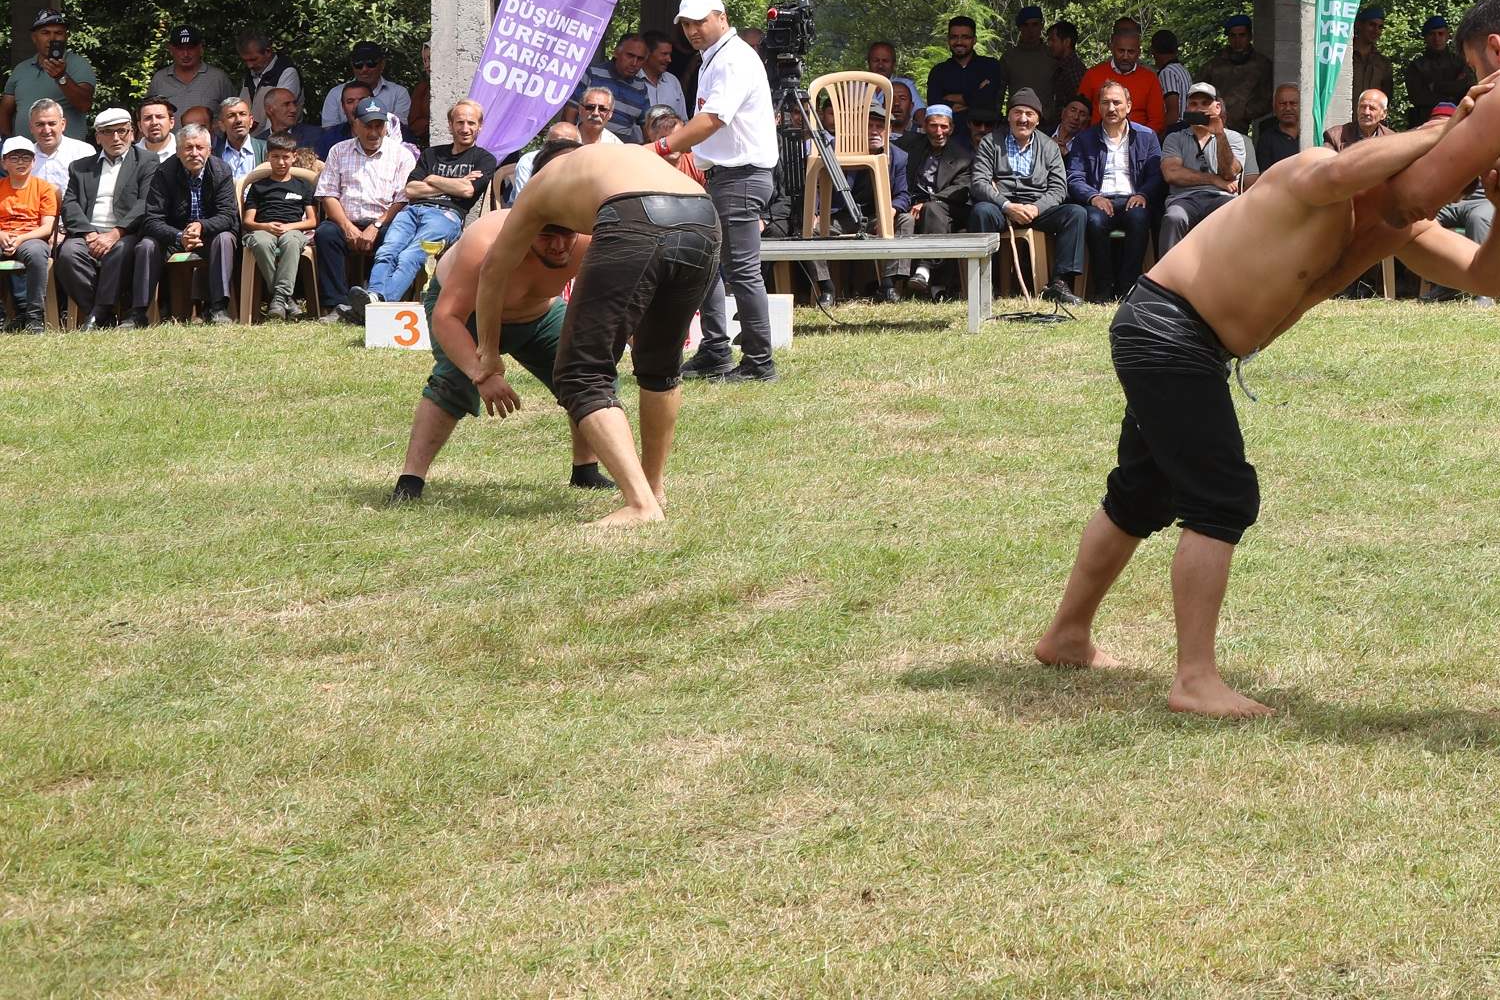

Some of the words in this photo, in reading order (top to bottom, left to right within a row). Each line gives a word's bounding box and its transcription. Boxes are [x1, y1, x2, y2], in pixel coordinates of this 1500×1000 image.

[493, 36, 578, 80] YARIŞAN
[497, 16, 587, 62] ÜRETEN
[482, 60, 570, 105] ORDU
[393, 310, 421, 347] 3
